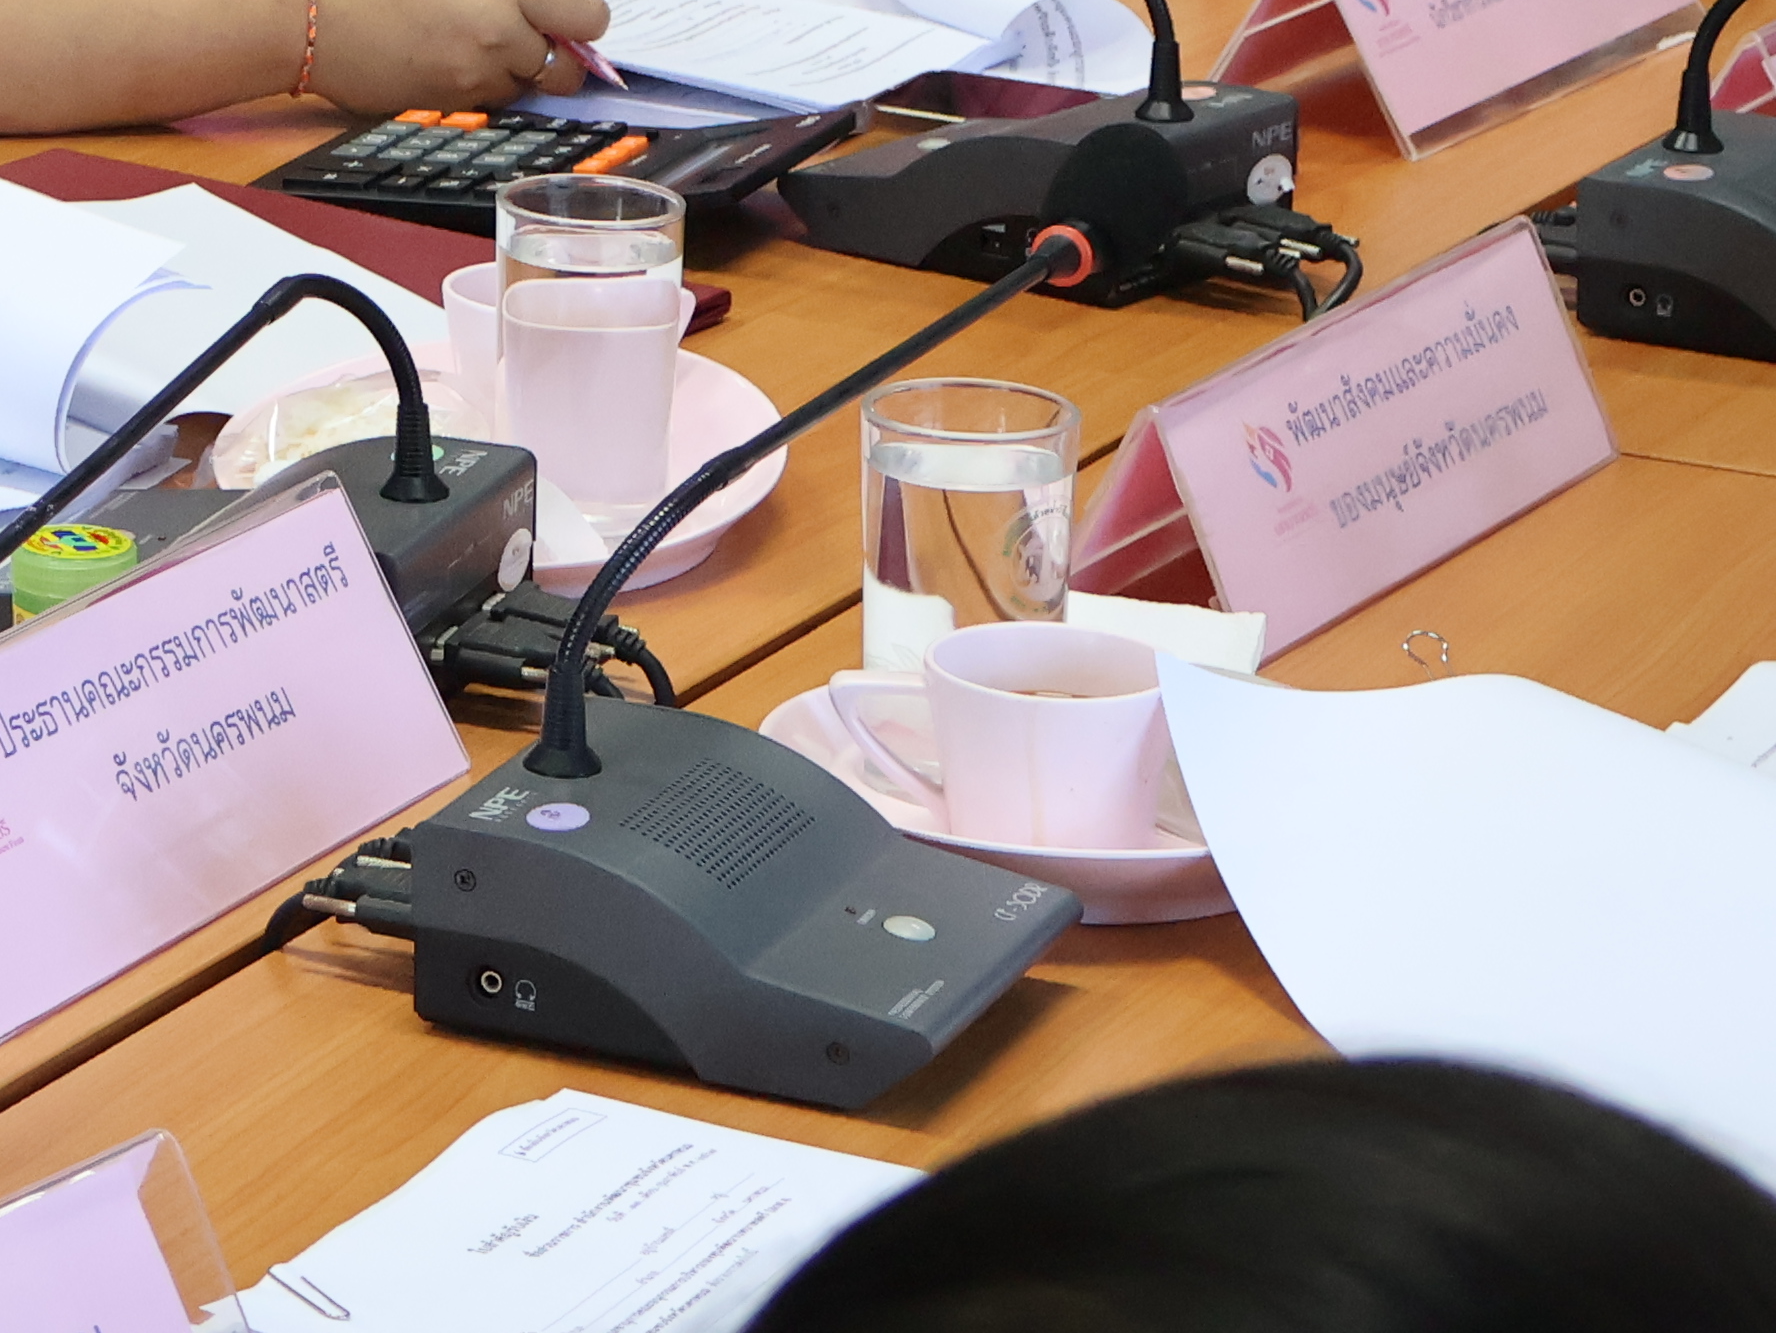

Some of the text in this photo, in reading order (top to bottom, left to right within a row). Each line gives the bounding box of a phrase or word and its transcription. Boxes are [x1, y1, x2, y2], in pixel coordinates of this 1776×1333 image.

[1285, 299, 1521, 450] พัฒนาสังคมและความมั่นคง
[501, 479, 534, 521] NPE
[1329, 387, 1549, 530] ของมนุษย์จังหวัดนครพนม
[114, 685, 298, 807] จังหวัดนครพนม
[468, 786, 533, 822] NPE
